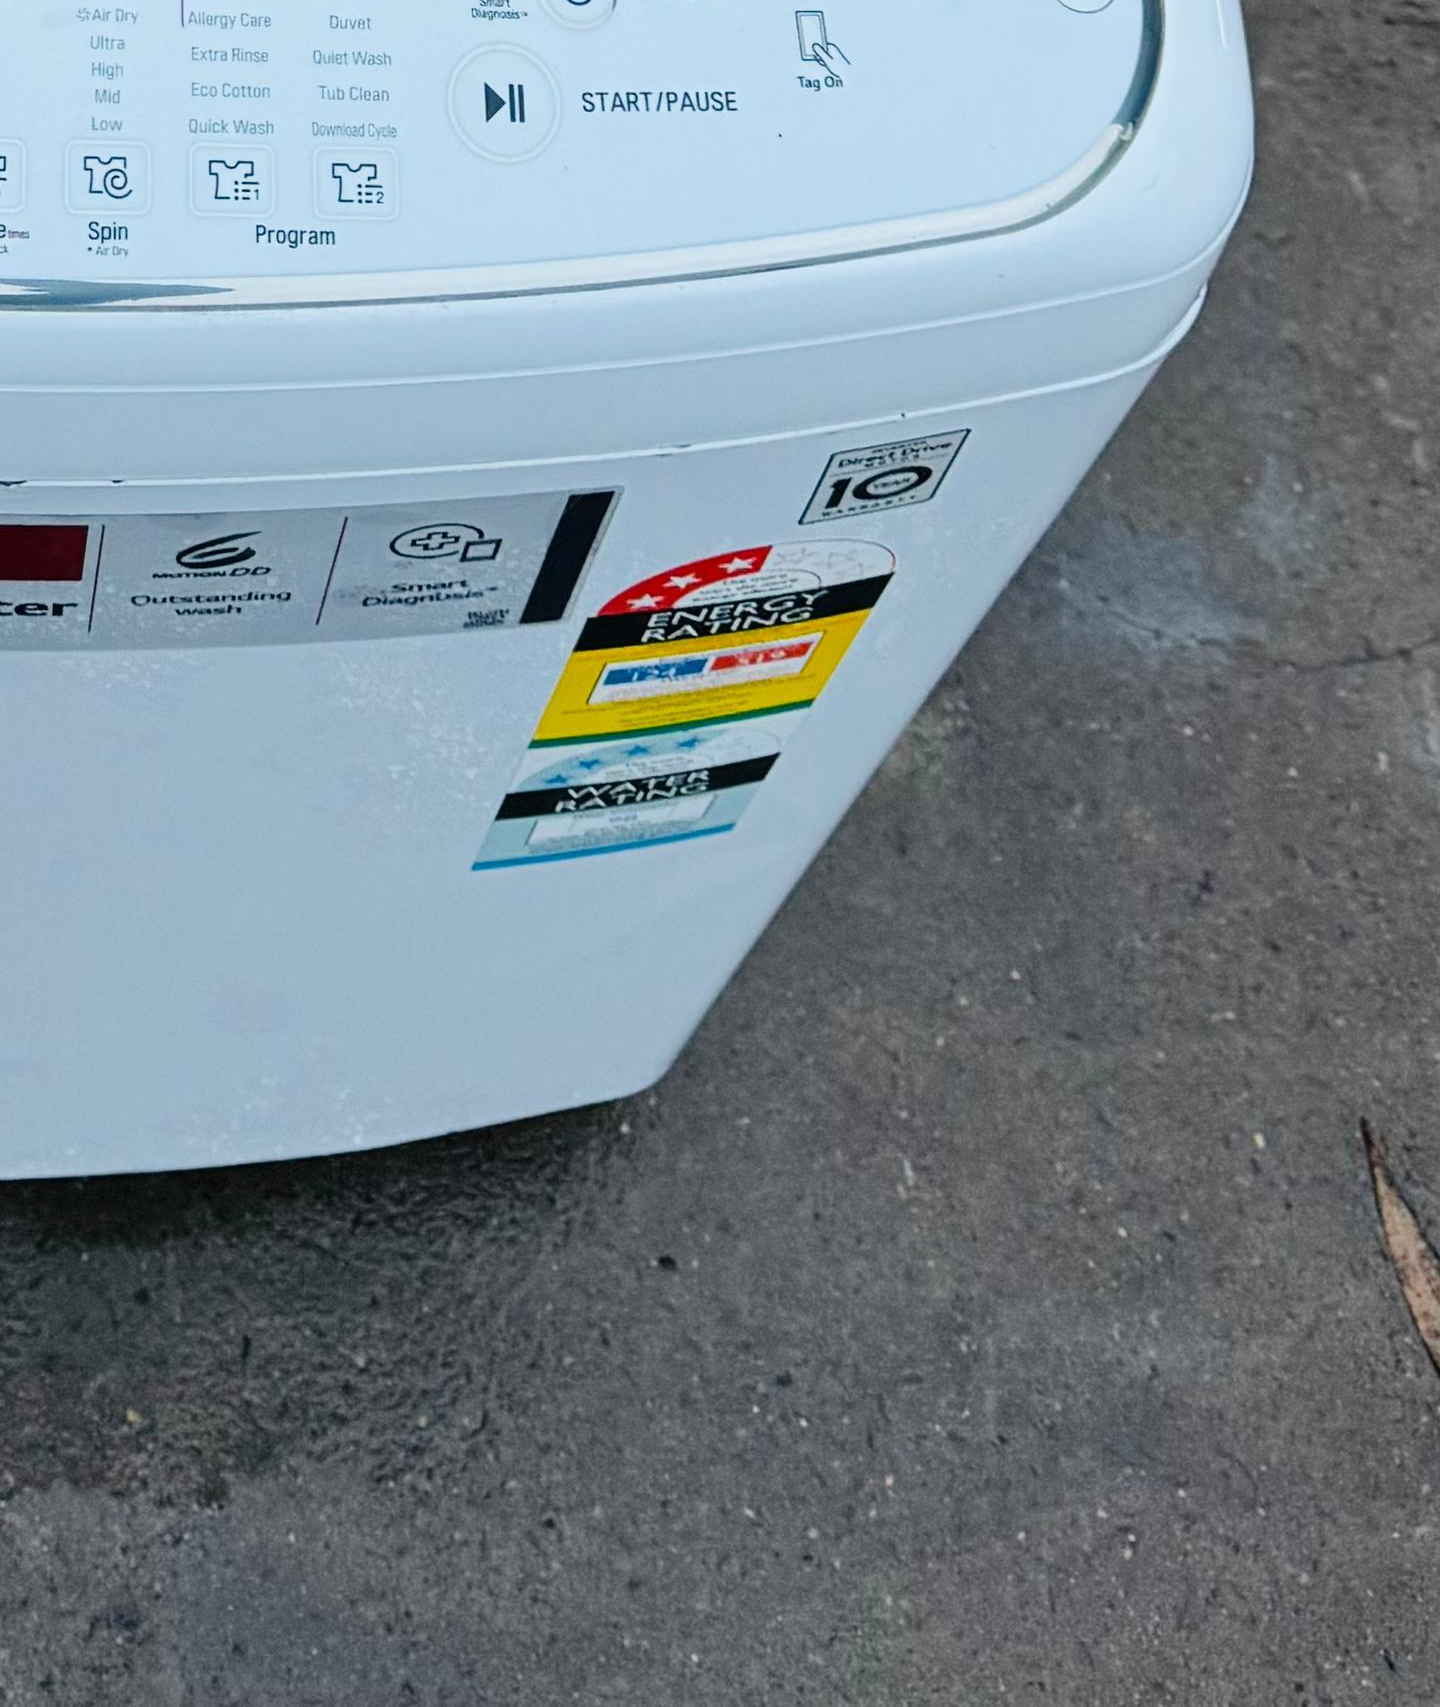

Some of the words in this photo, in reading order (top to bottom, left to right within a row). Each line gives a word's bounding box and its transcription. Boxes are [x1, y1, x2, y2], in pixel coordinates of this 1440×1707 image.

[91, 8, 111, 22] Air
[115, 7, 139, 26] Dry
[187, 10, 237, 30] Allergy
[240, 12, 272, 28] Care
[329, 14, 372, 30] Duvet
[89, 35, 126, 51] Ultra
[191, 46, 228, 63] Extra
[231, 47, 269, 64] Rinse
[312, 49, 349, 66] Quiet
[351, 50, 392, 67] Wash
[91, 61, 124, 81] High
[191, 81, 218, 98] Eco
[221, 82, 271, 99] Cotton
[796, 75, 822, 92] Tag
[824, 74, 844, 88] On
[94, 88, 121, 105] Mid
[317, 84, 346, 101] Tub
[349, 86, 390, 102] Clean
[581, 90, 739, 113] START/PAUSE
[91, 115, 124, 132] Low
[188, 117, 229, 135] Quick
[232, 119, 275, 136] Wash
[311, 121, 366, 138] Download
[367, 122, 398, 141] Cycle
[88, 221, 129, 244] Spin
[255, 224, 336, 250] Program
[96, 245, 110, 256] Air
[112, 246, 129, 257] Dry
[838, 452, 895, 468] Direct
[901, 442, 952, 456] Drive
[824, 466, 933, 509] 10
[392, 580, 469, 592] Smart
[131, 591, 291, 606] Outstanding
[176, 605, 242, 615] wash
[647, 589, 829, 628] ENERGY
[641, 607, 813, 643] RATING
[568, 769, 709, 799] WATER
[555, 783, 709, 813] RATING
